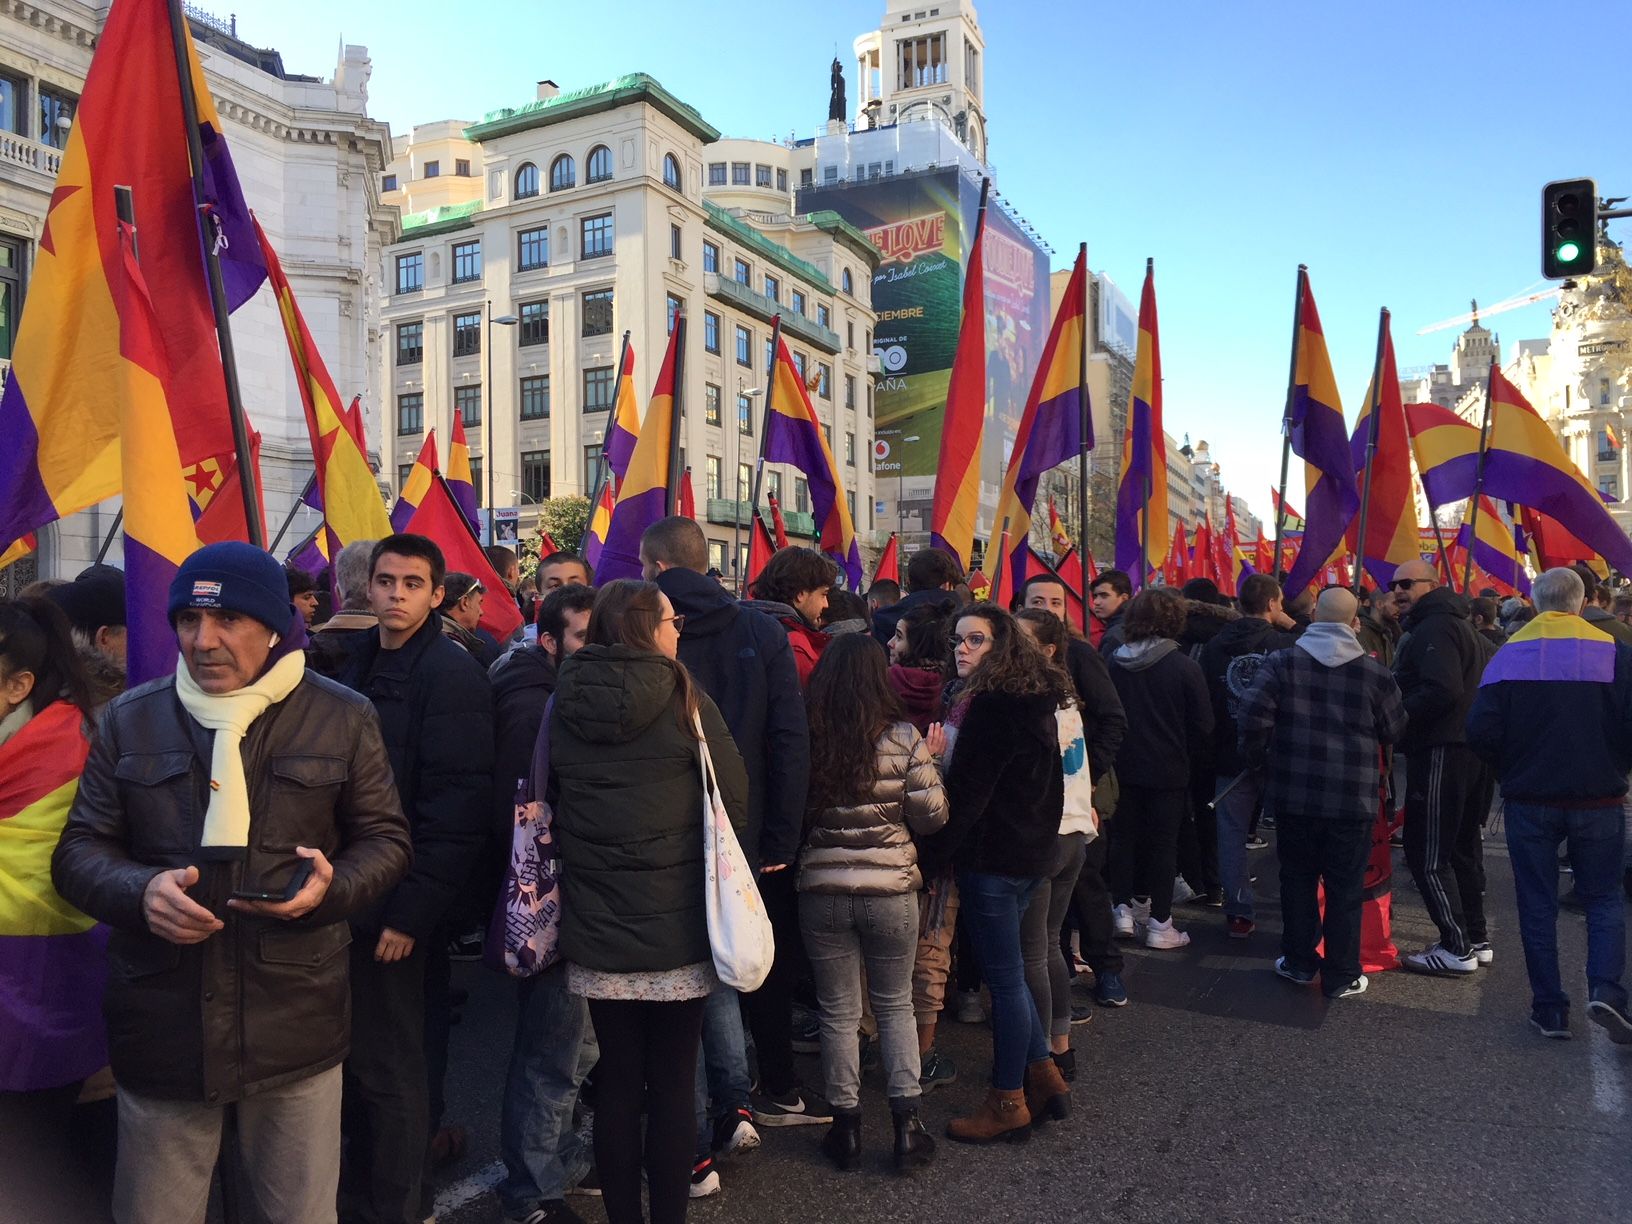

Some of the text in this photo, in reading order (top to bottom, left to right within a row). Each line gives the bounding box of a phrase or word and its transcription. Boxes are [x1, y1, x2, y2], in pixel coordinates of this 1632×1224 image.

[888, 215, 945, 256] LOVE
[876, 306, 924, 322] CIEMBRE
[898, 335, 908, 343] DE
[876, 377, 907, 392] AÑA
[874, 462, 901, 471] afone
